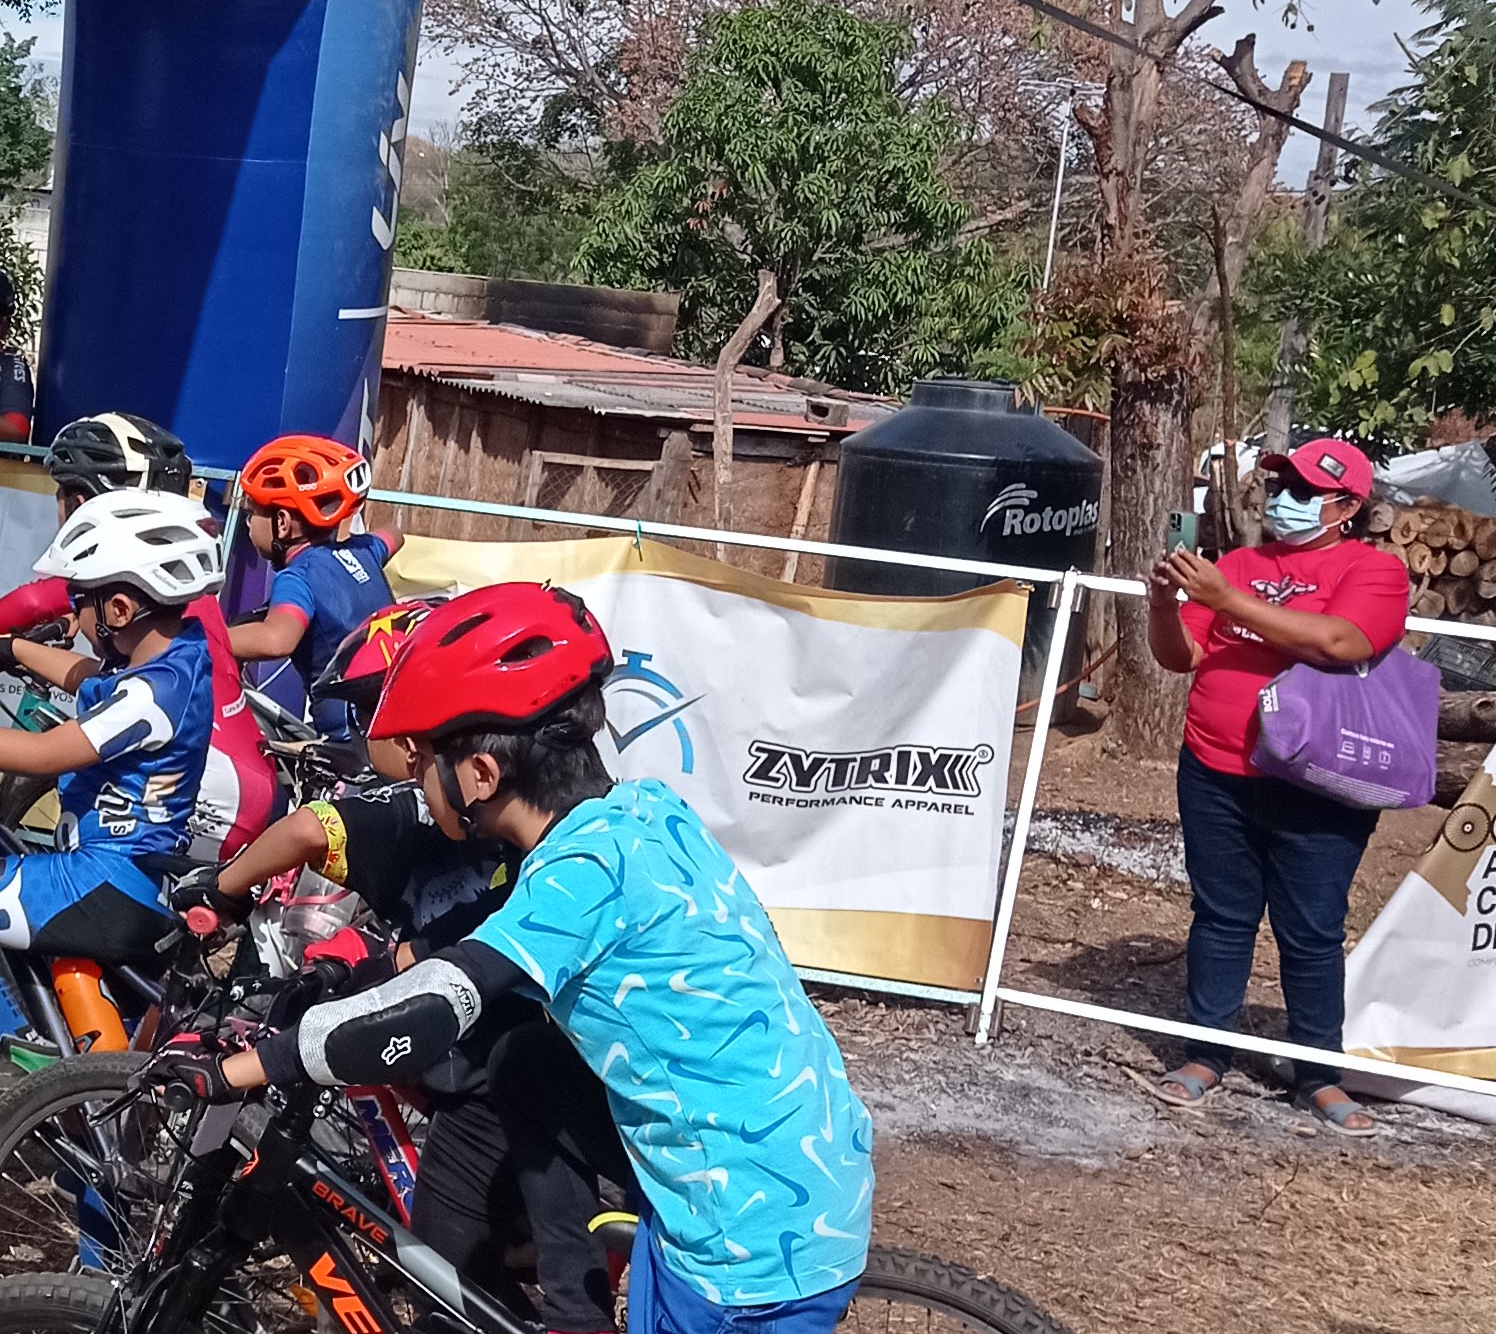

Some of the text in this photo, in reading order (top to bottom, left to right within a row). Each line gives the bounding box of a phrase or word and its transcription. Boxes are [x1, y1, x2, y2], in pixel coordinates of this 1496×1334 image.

[1002, 499, 1099, 537] Rotoplas
[745, 741, 980, 796] ZYTRIX
[748, 790, 975, 816] PERFORMANCE APPAREL
[311, 1180, 389, 1244] BRAVE
